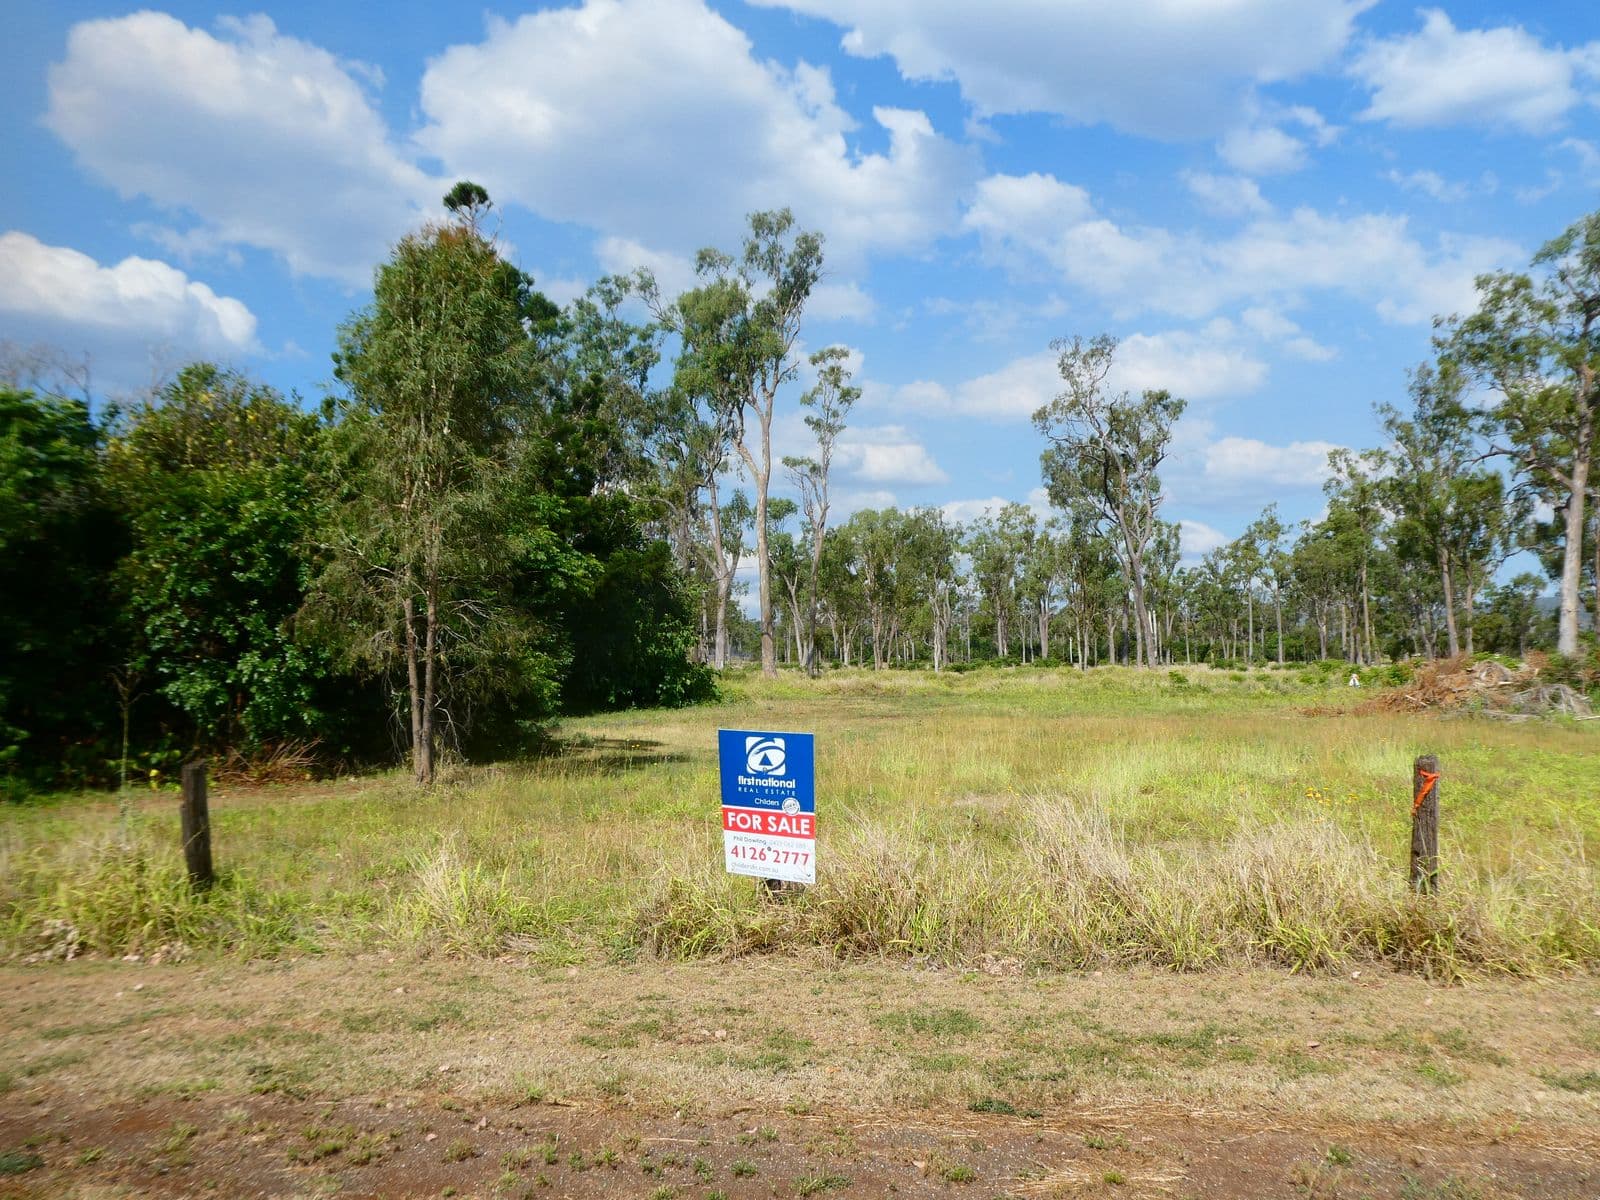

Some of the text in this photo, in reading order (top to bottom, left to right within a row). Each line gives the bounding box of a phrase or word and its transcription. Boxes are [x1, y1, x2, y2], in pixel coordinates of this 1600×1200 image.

[754, 797, 780, 806] Childers
[727, 812, 810, 835] FOR SALE
[744, 836, 767, 845] Dowling
[731, 845, 809, 866] 4126 2777
